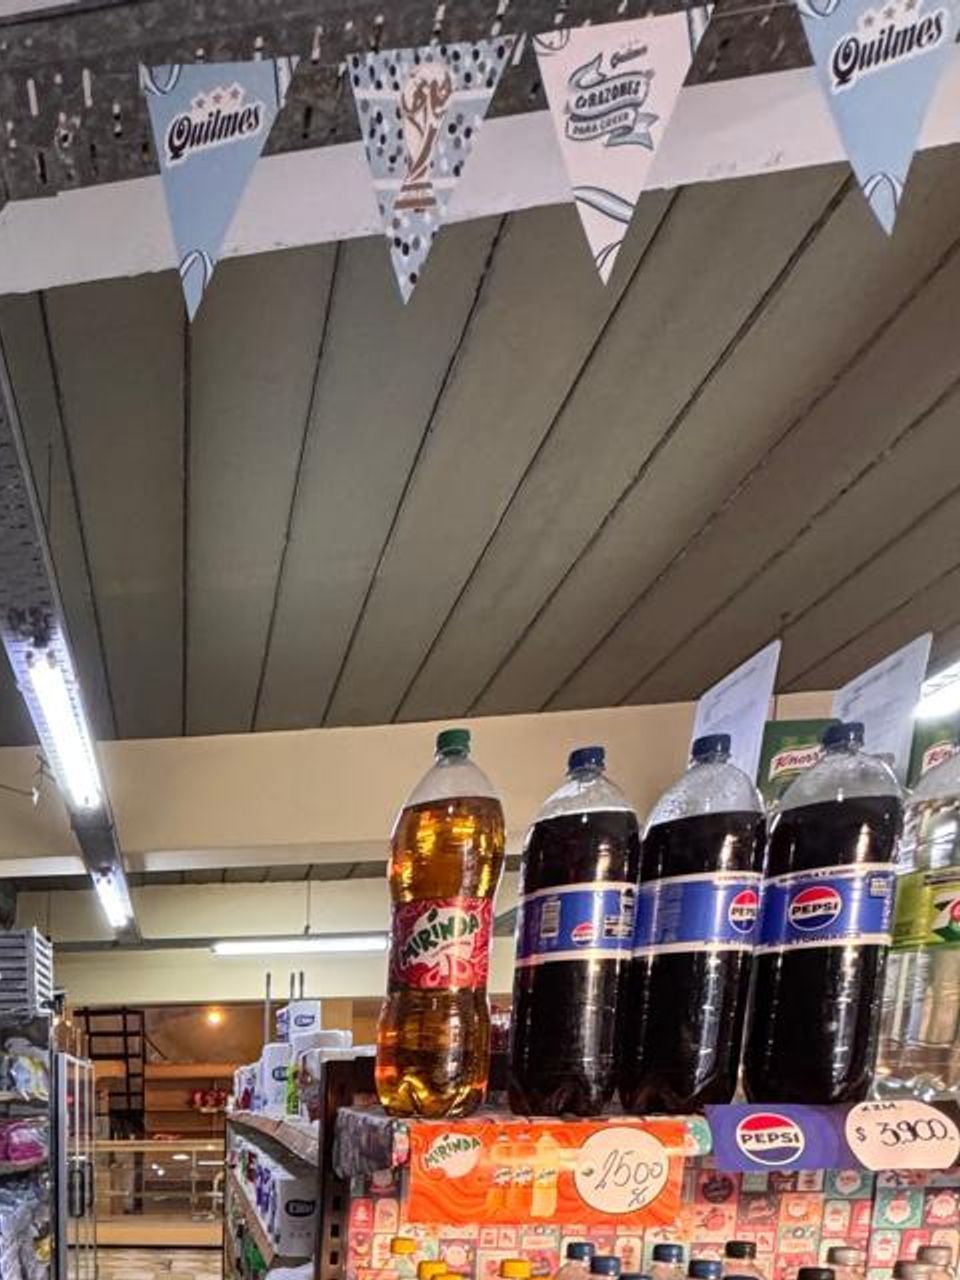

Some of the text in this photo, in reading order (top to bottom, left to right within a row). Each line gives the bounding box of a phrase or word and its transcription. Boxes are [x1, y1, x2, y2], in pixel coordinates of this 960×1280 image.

[832, 10, 943, 87] Quilmes
[168, 104, 260, 160] Quilmes
[791, 901, 839, 917] PEPSI
[424, 1133, 481, 1169] MIRINDA
[741, 1131, 800, 1145] PEPSI
